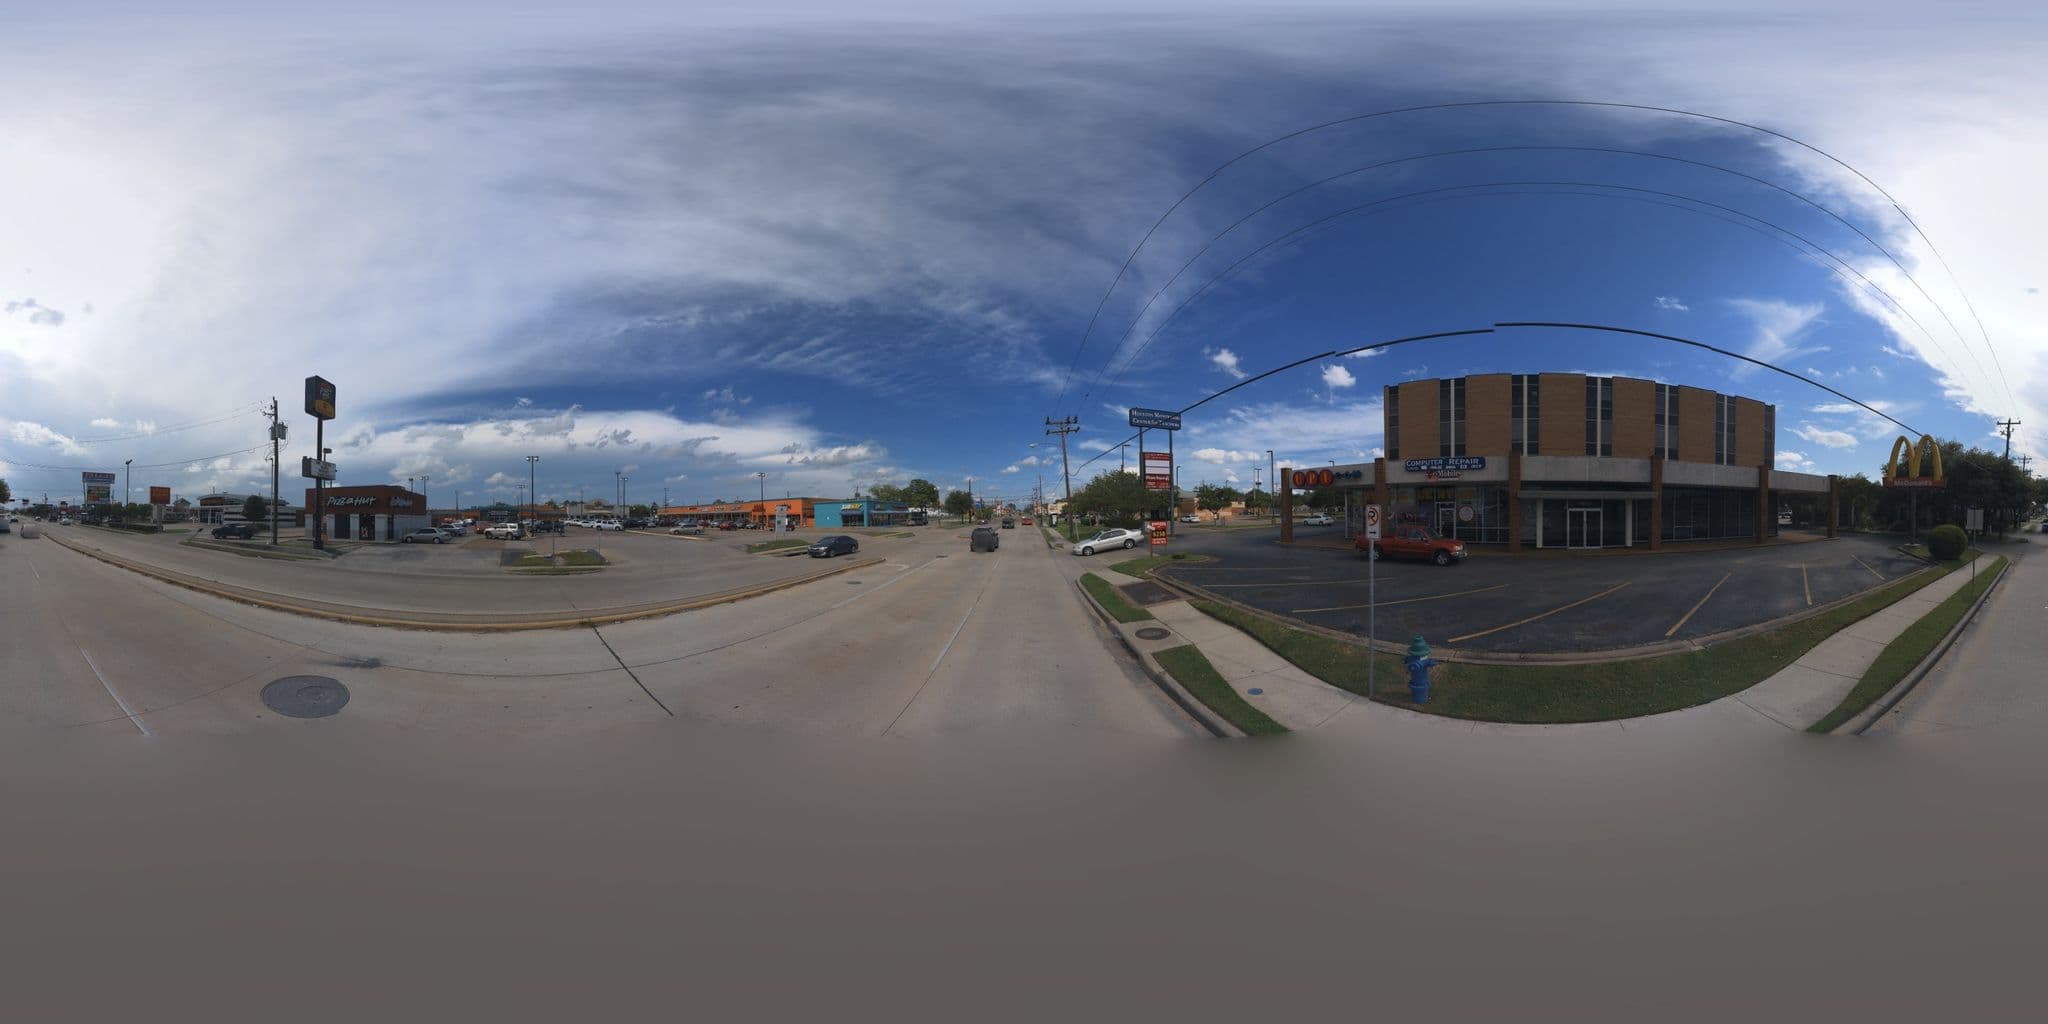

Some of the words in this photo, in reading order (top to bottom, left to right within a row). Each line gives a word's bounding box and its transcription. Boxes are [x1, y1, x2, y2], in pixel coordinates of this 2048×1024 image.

[1406, 459, 1443, 467] COMPUTER
[327, 496, 354, 506] Pizza
[354, 496, 377, 506] Hut
